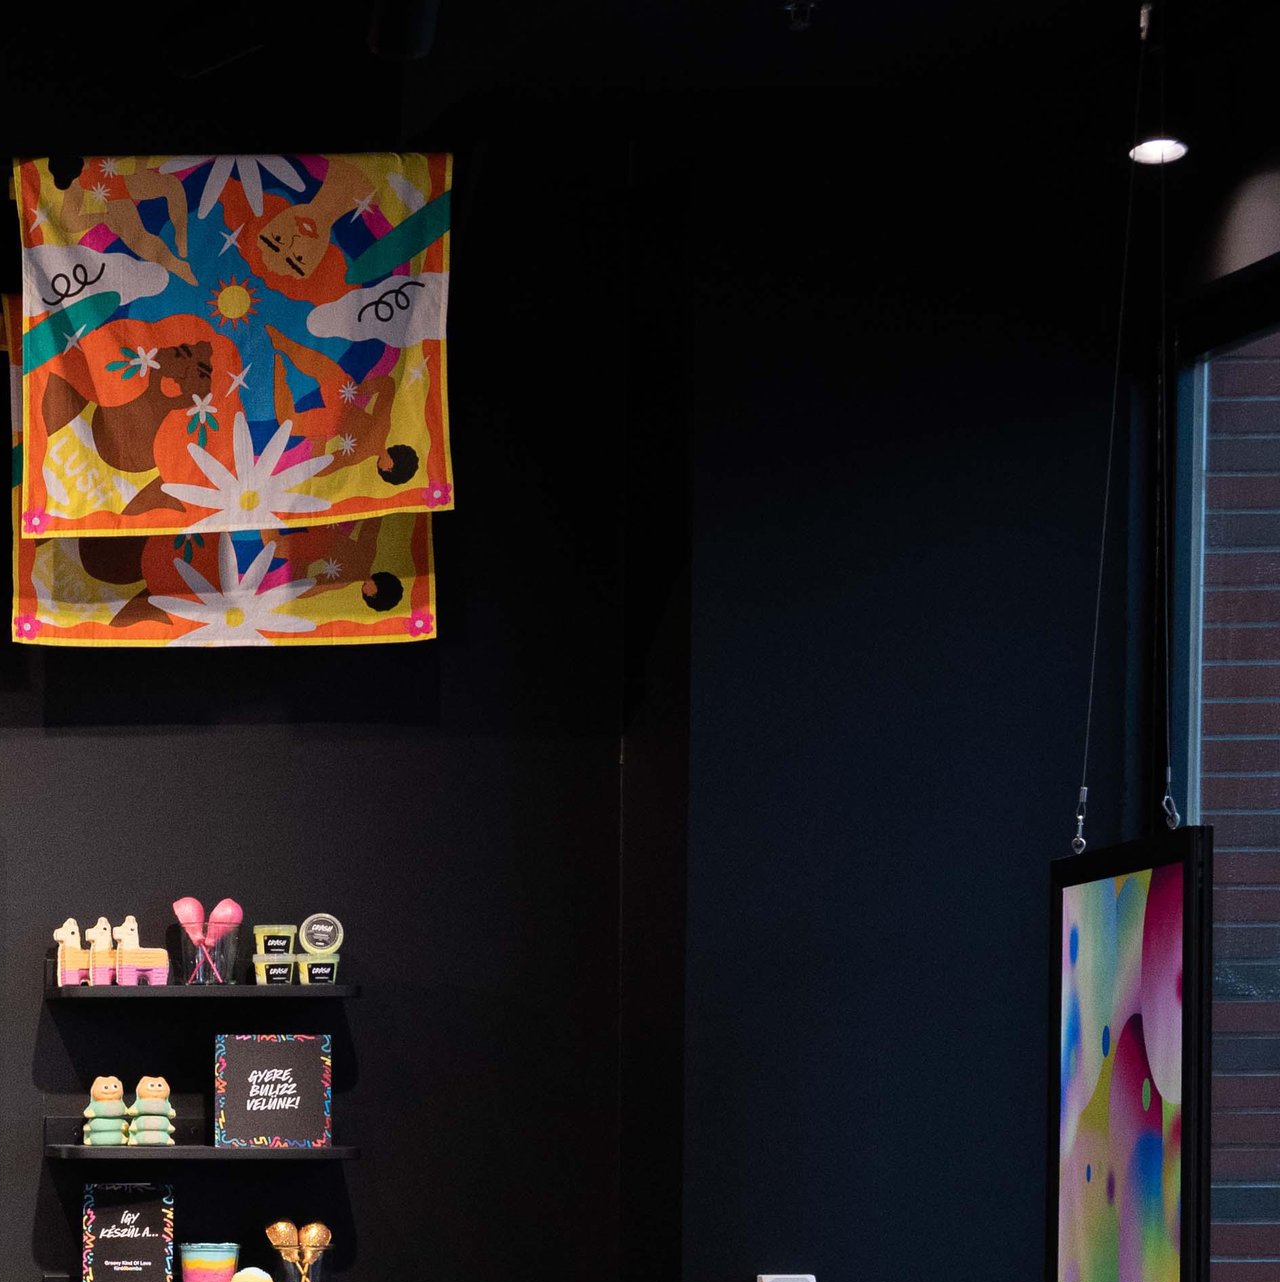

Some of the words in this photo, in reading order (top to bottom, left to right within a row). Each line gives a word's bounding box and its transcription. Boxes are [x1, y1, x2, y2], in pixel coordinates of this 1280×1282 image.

[247, 1068, 294, 1084] GYERE,
[250, 1082, 298, 1097] BULIZZ
[246, 1093, 301, 1111] VELÜNK!
[120, 1209, 141, 1226] ÍGY
[99, 1223, 142, 1239] KÉSZÜL
